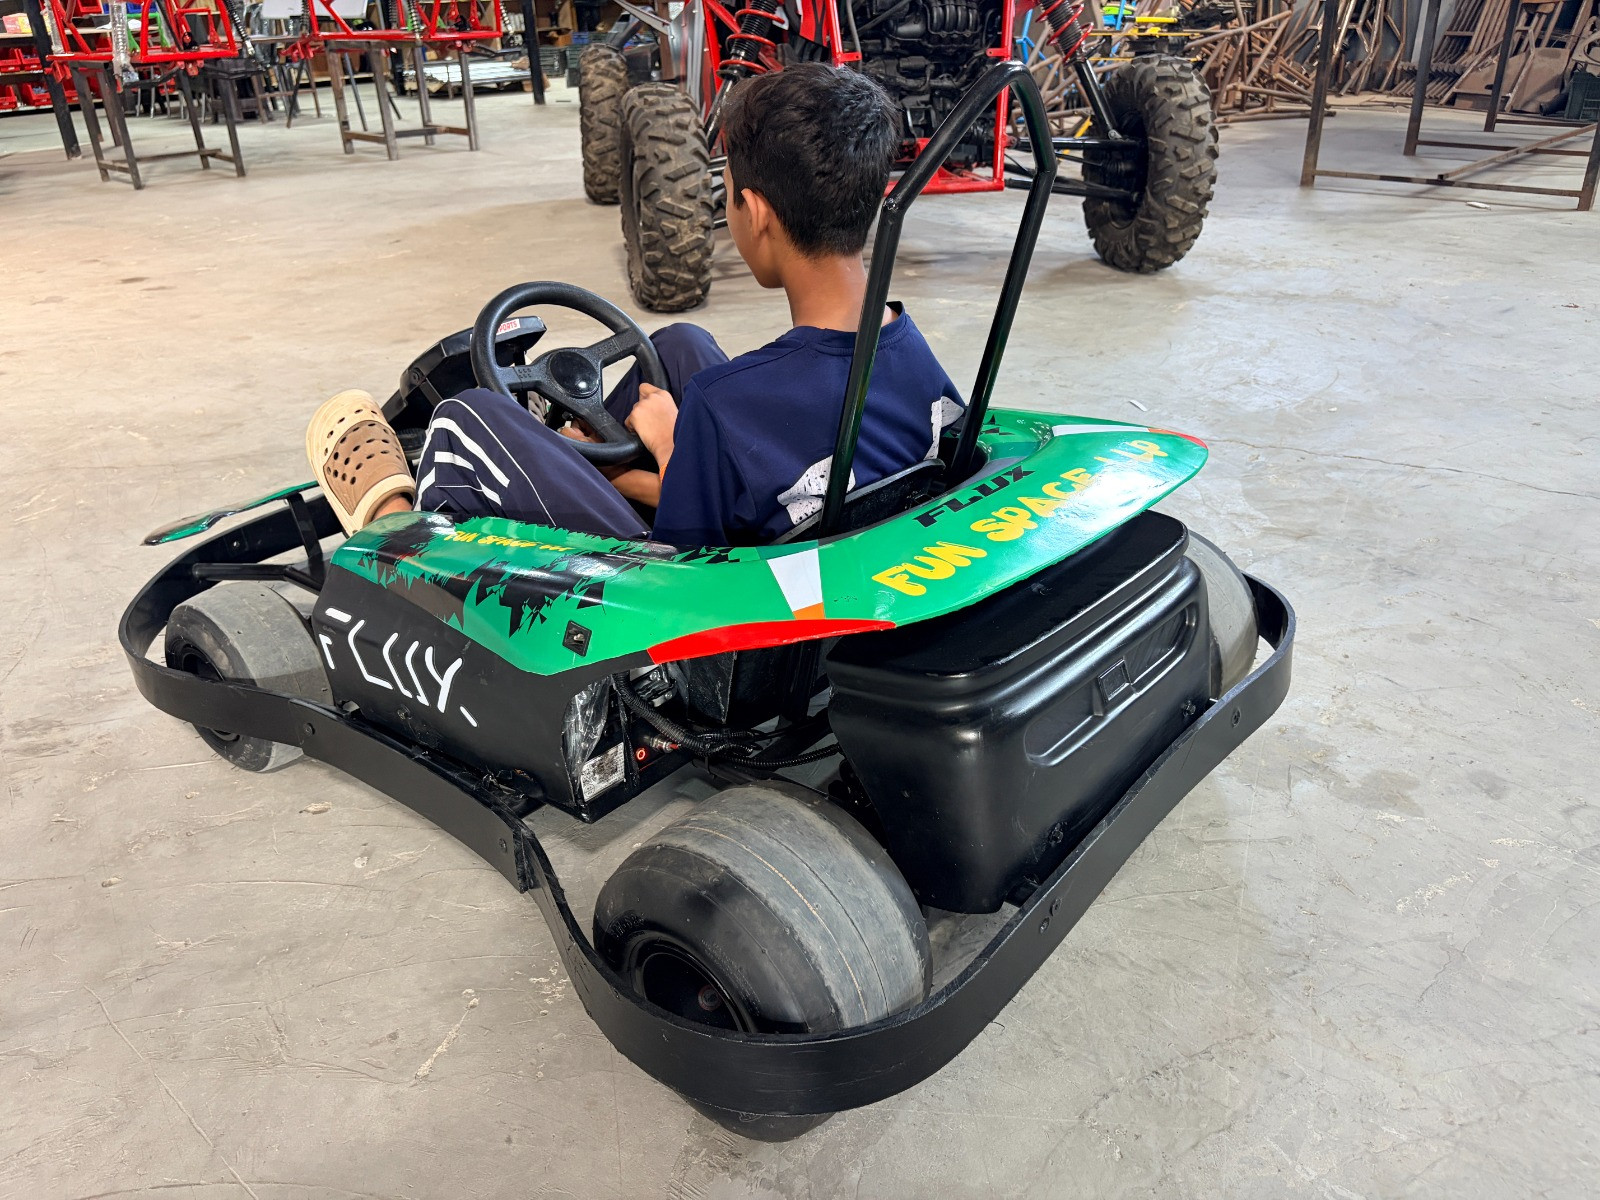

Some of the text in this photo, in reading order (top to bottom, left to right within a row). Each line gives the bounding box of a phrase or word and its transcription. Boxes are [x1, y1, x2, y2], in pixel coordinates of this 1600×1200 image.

[871, 541, 988, 597] FUN
[969, 467, 1095, 542] SPACE
[912, 465, 1035, 528] FLUX
